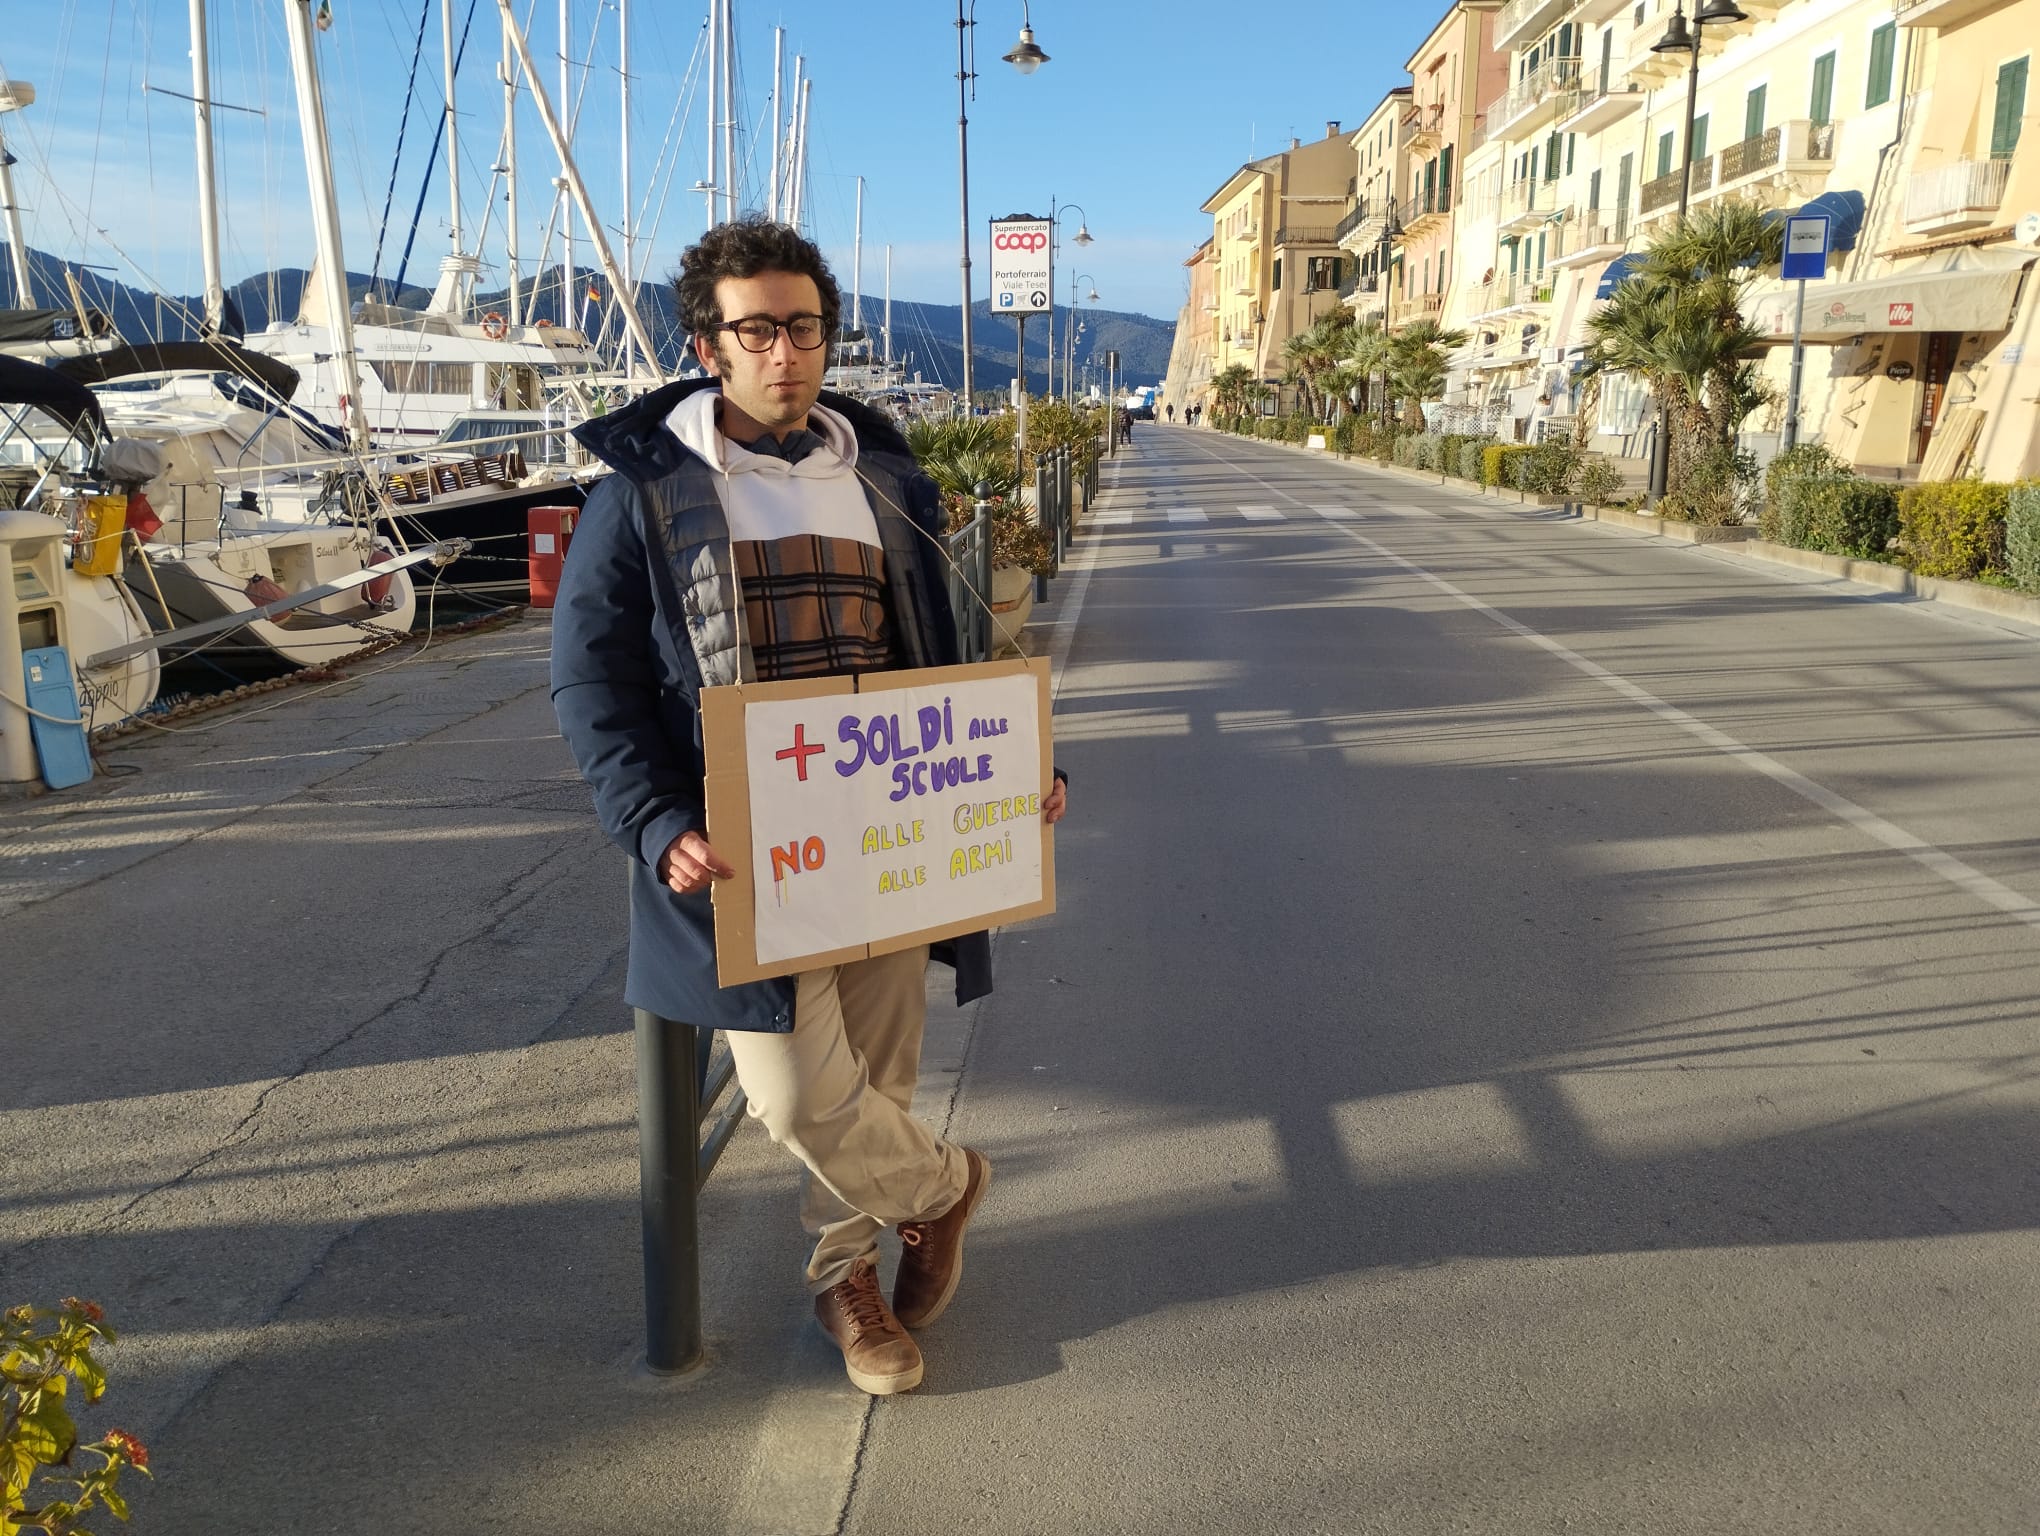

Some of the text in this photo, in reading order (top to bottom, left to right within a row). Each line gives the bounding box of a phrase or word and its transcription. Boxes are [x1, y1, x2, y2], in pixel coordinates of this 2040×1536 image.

[994, 224, 1047, 234] Supermercato
[995, 233, 1047, 254] coop
[995, 270, 1047, 279] Portoferraio
[1002, 281, 1047, 289] Viale Tesei
[1889, 305, 1912, 324] illy
[969, 718, 1008, 740] ALLE
[889, 754, 993, 802] SCUOLE
[770, 792, 1040, 882] NO ALLE GUERRE
[879, 865, 927, 894] ALLE
